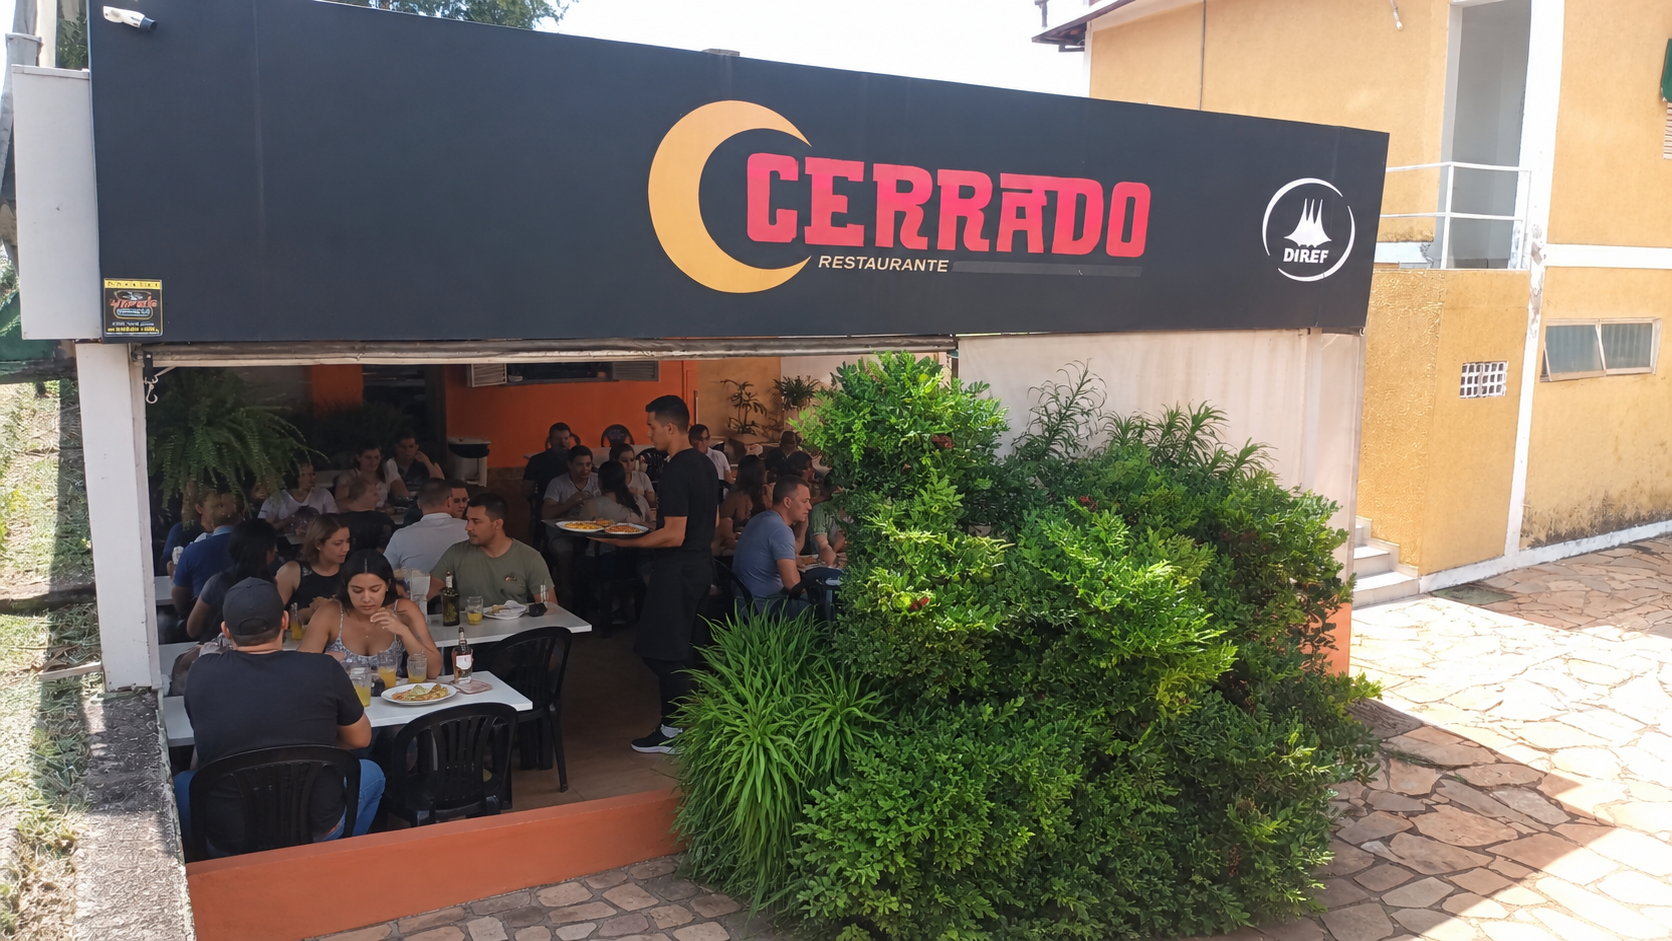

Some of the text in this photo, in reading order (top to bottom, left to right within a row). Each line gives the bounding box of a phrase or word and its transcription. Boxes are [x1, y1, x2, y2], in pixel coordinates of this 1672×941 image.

[747, 152, 1152, 258] CERRADO
[818, 255, 950, 273] RESTAURANTE
[1283, 247, 1329, 263] DIREF
